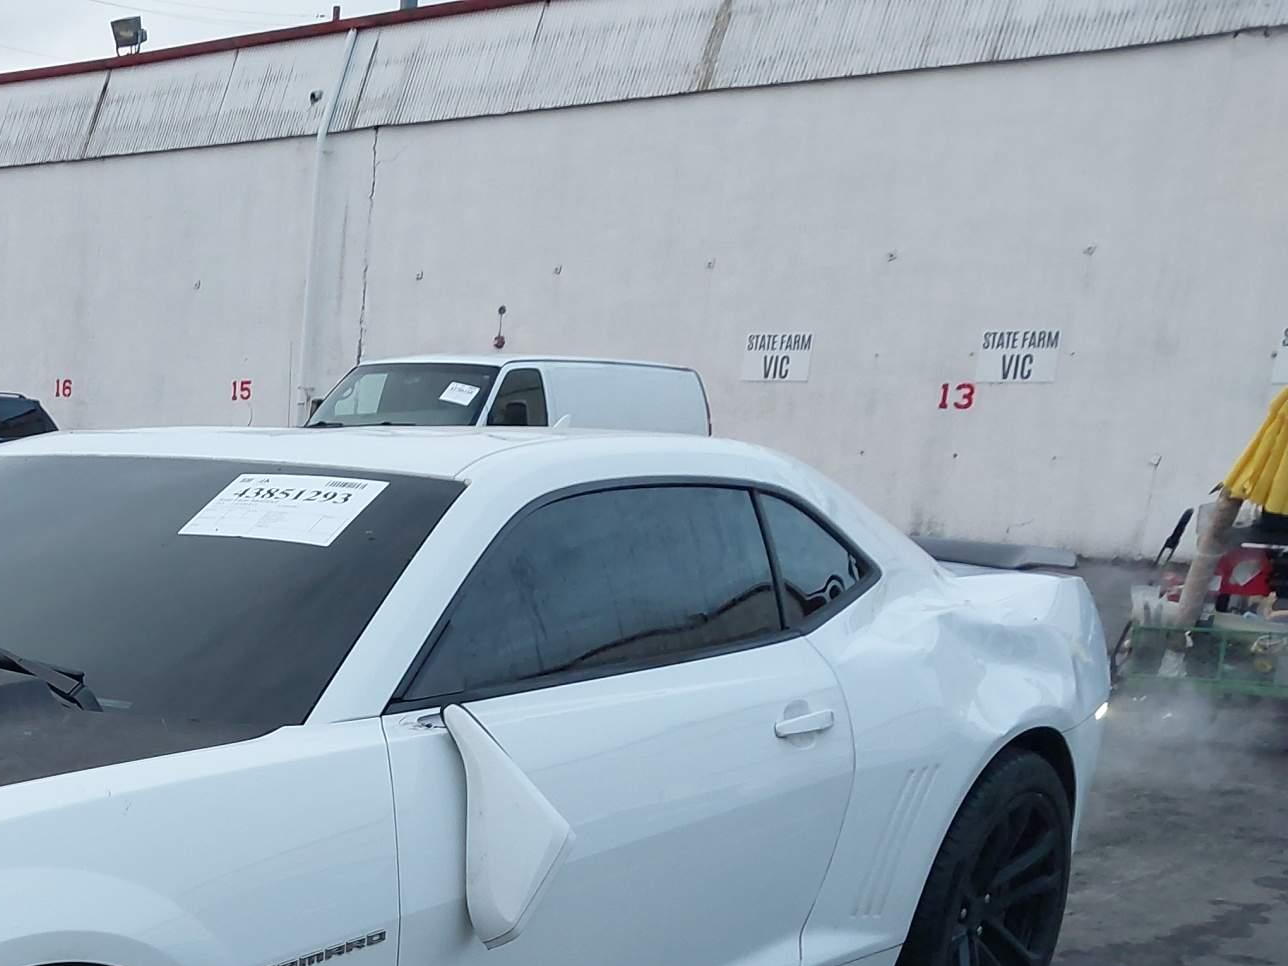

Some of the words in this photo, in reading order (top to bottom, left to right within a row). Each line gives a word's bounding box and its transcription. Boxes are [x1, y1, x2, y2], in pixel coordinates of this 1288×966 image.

[747, 334, 778, 351] STATE
[779, 334, 813, 351] FARM
[983, 330, 1019, 349] STATE
[1021, 330, 1060, 348] FARM
[763, 355, 790, 379] VIC
[1001, 354, 1033, 380] VIC
[55, 379, 72, 398] 16
[231, 380, 252, 400] 15
[938, 383, 975, 409] 13
[233, 487, 352, 504] 43851293
